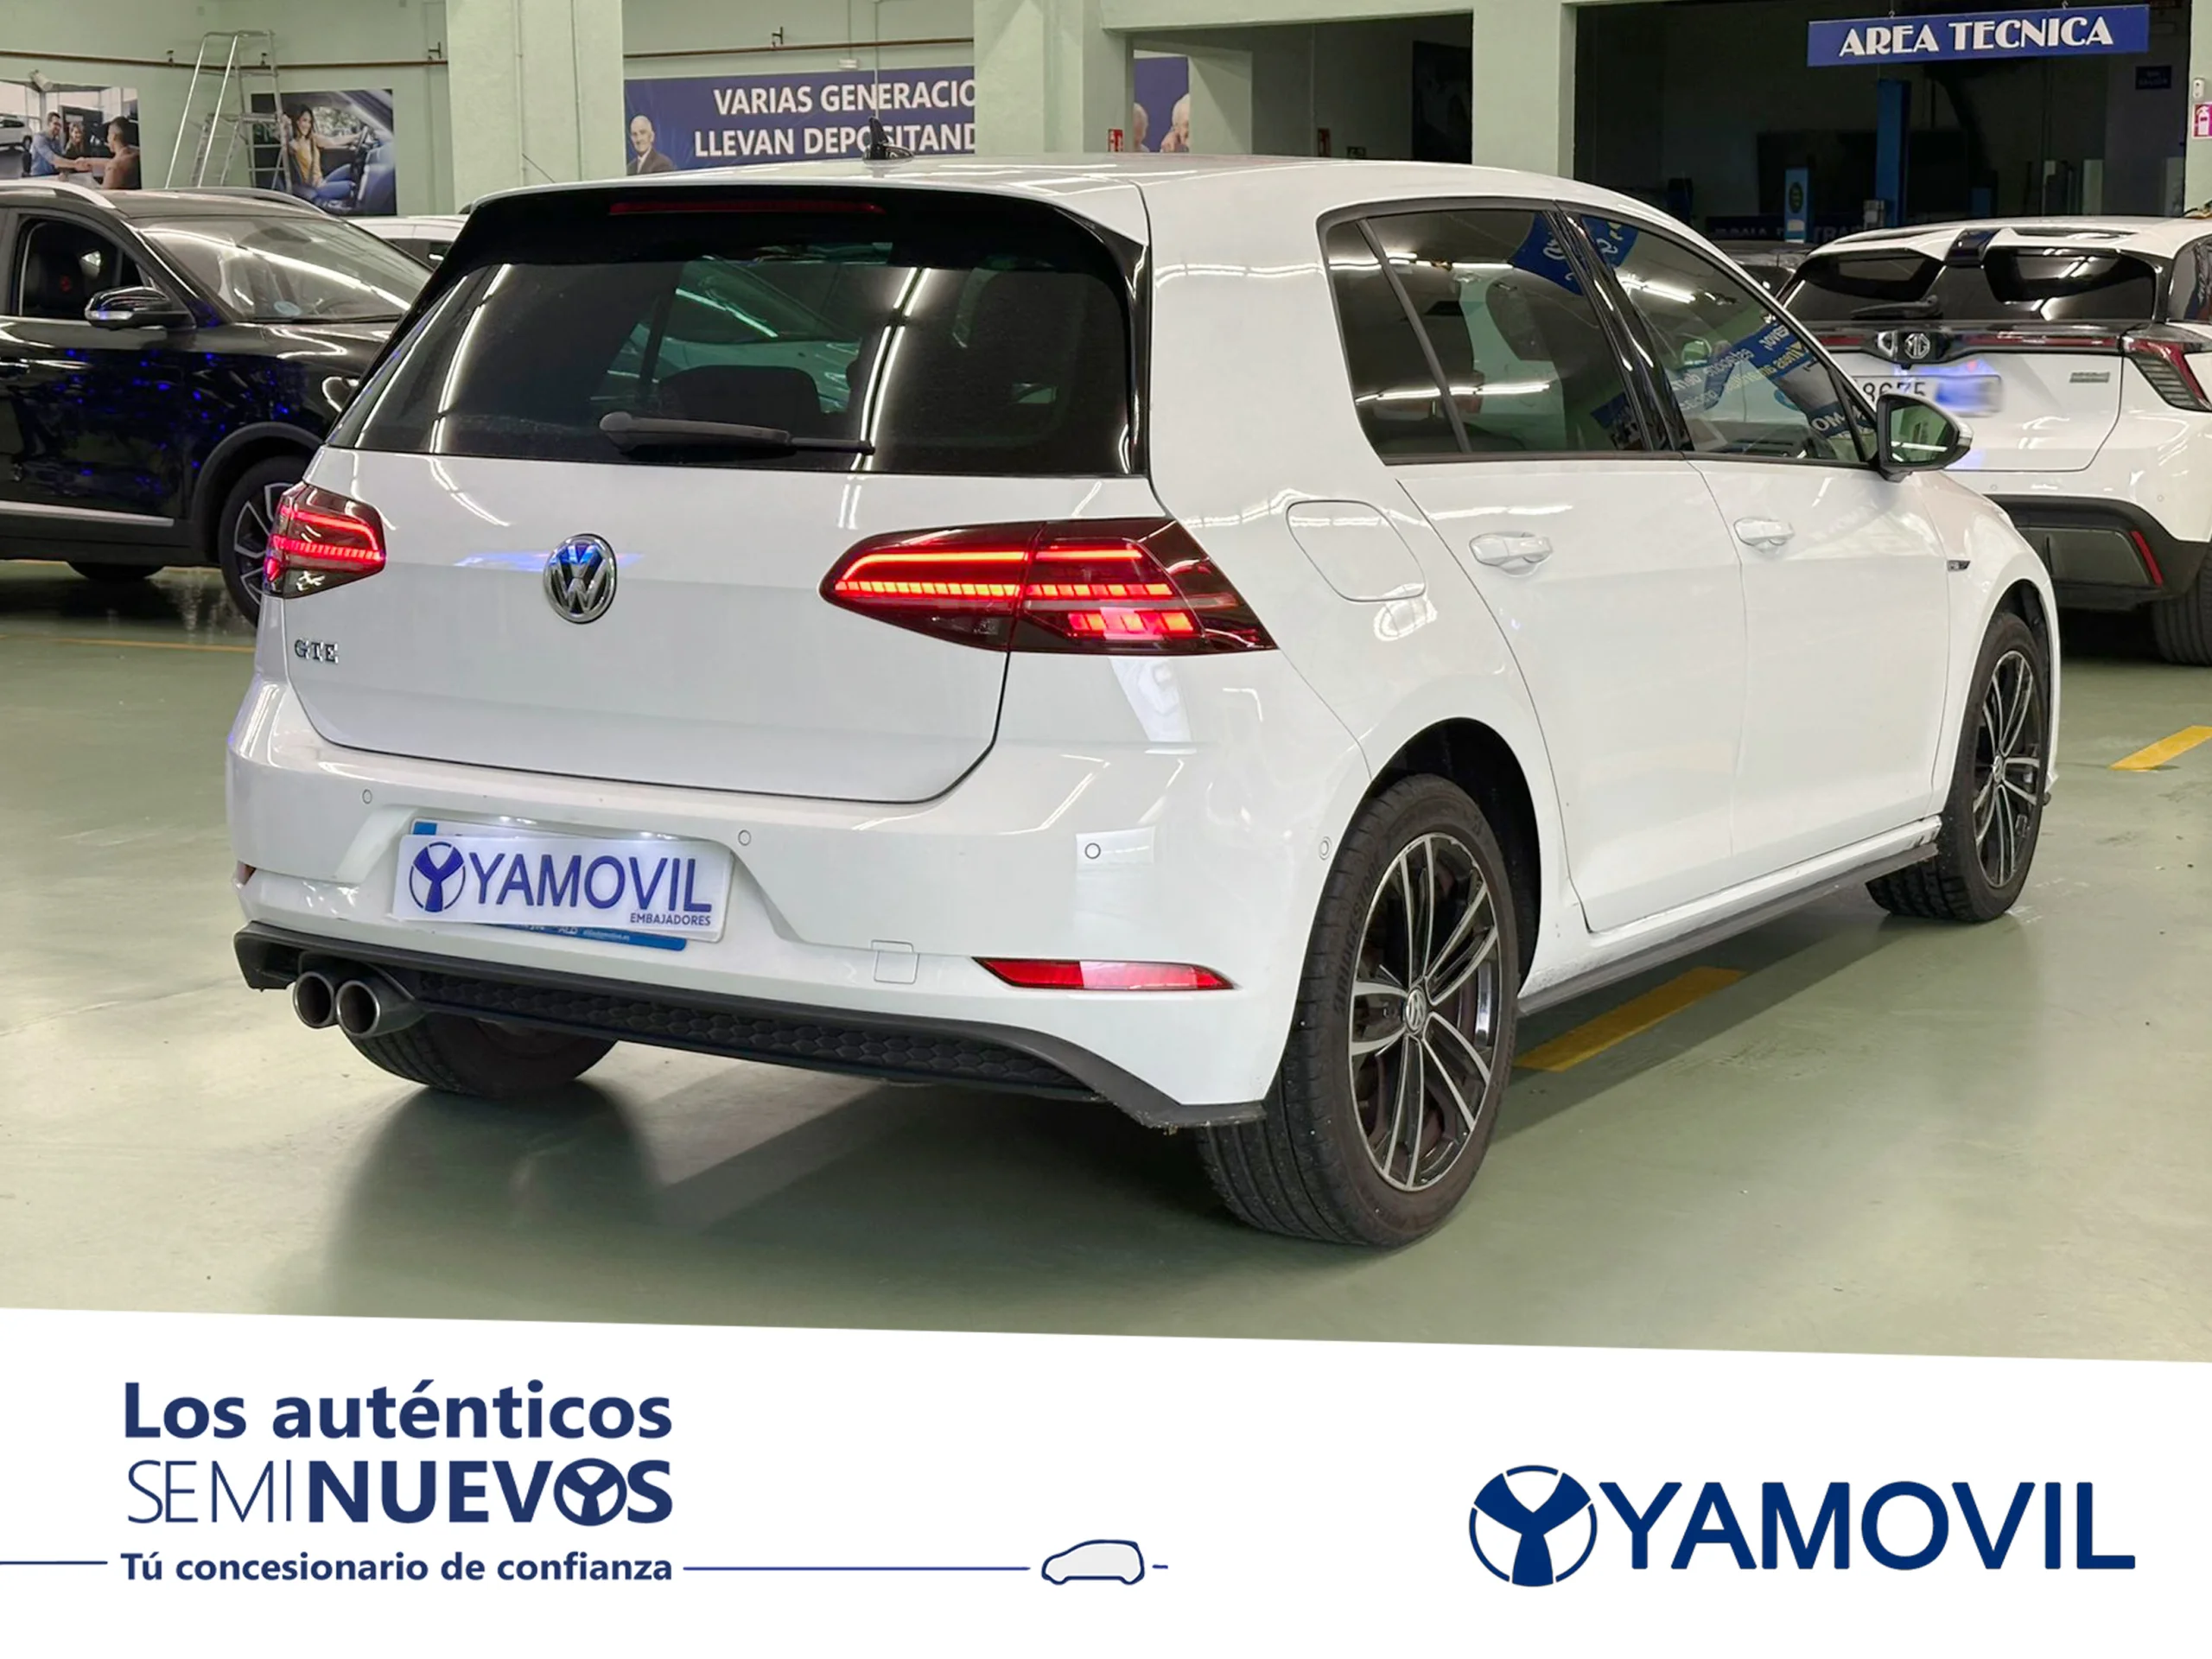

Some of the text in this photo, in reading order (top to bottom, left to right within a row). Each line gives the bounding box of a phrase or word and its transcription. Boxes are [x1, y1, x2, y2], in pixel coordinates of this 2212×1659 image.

[1839, 16, 2113, 57] AREA TECNICA
[714, 79, 975, 115] VARIAS GENERACIO
[695, 128, 794, 157] LLEVAN
[294, 638, 339, 664] GTE
[468, 852, 712, 912] YAMOVIL
[630, 912, 712, 926] EMBAJADORES
